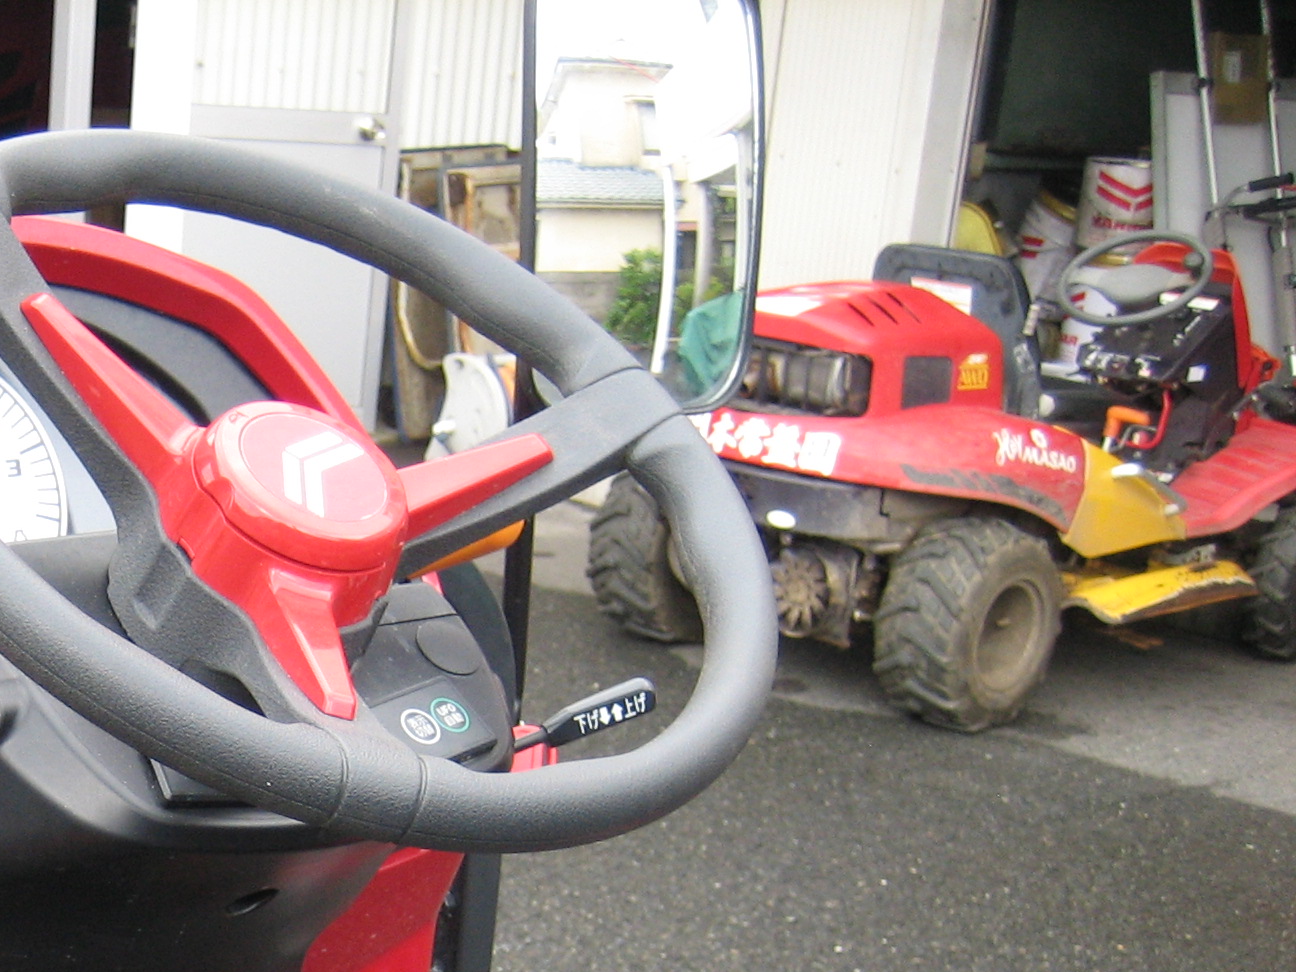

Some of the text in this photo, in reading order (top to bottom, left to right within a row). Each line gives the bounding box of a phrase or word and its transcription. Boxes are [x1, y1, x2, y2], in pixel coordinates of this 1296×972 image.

[7, 459, 21, 477] 3
[573, 692, 646, 735] 下げ 上げ
